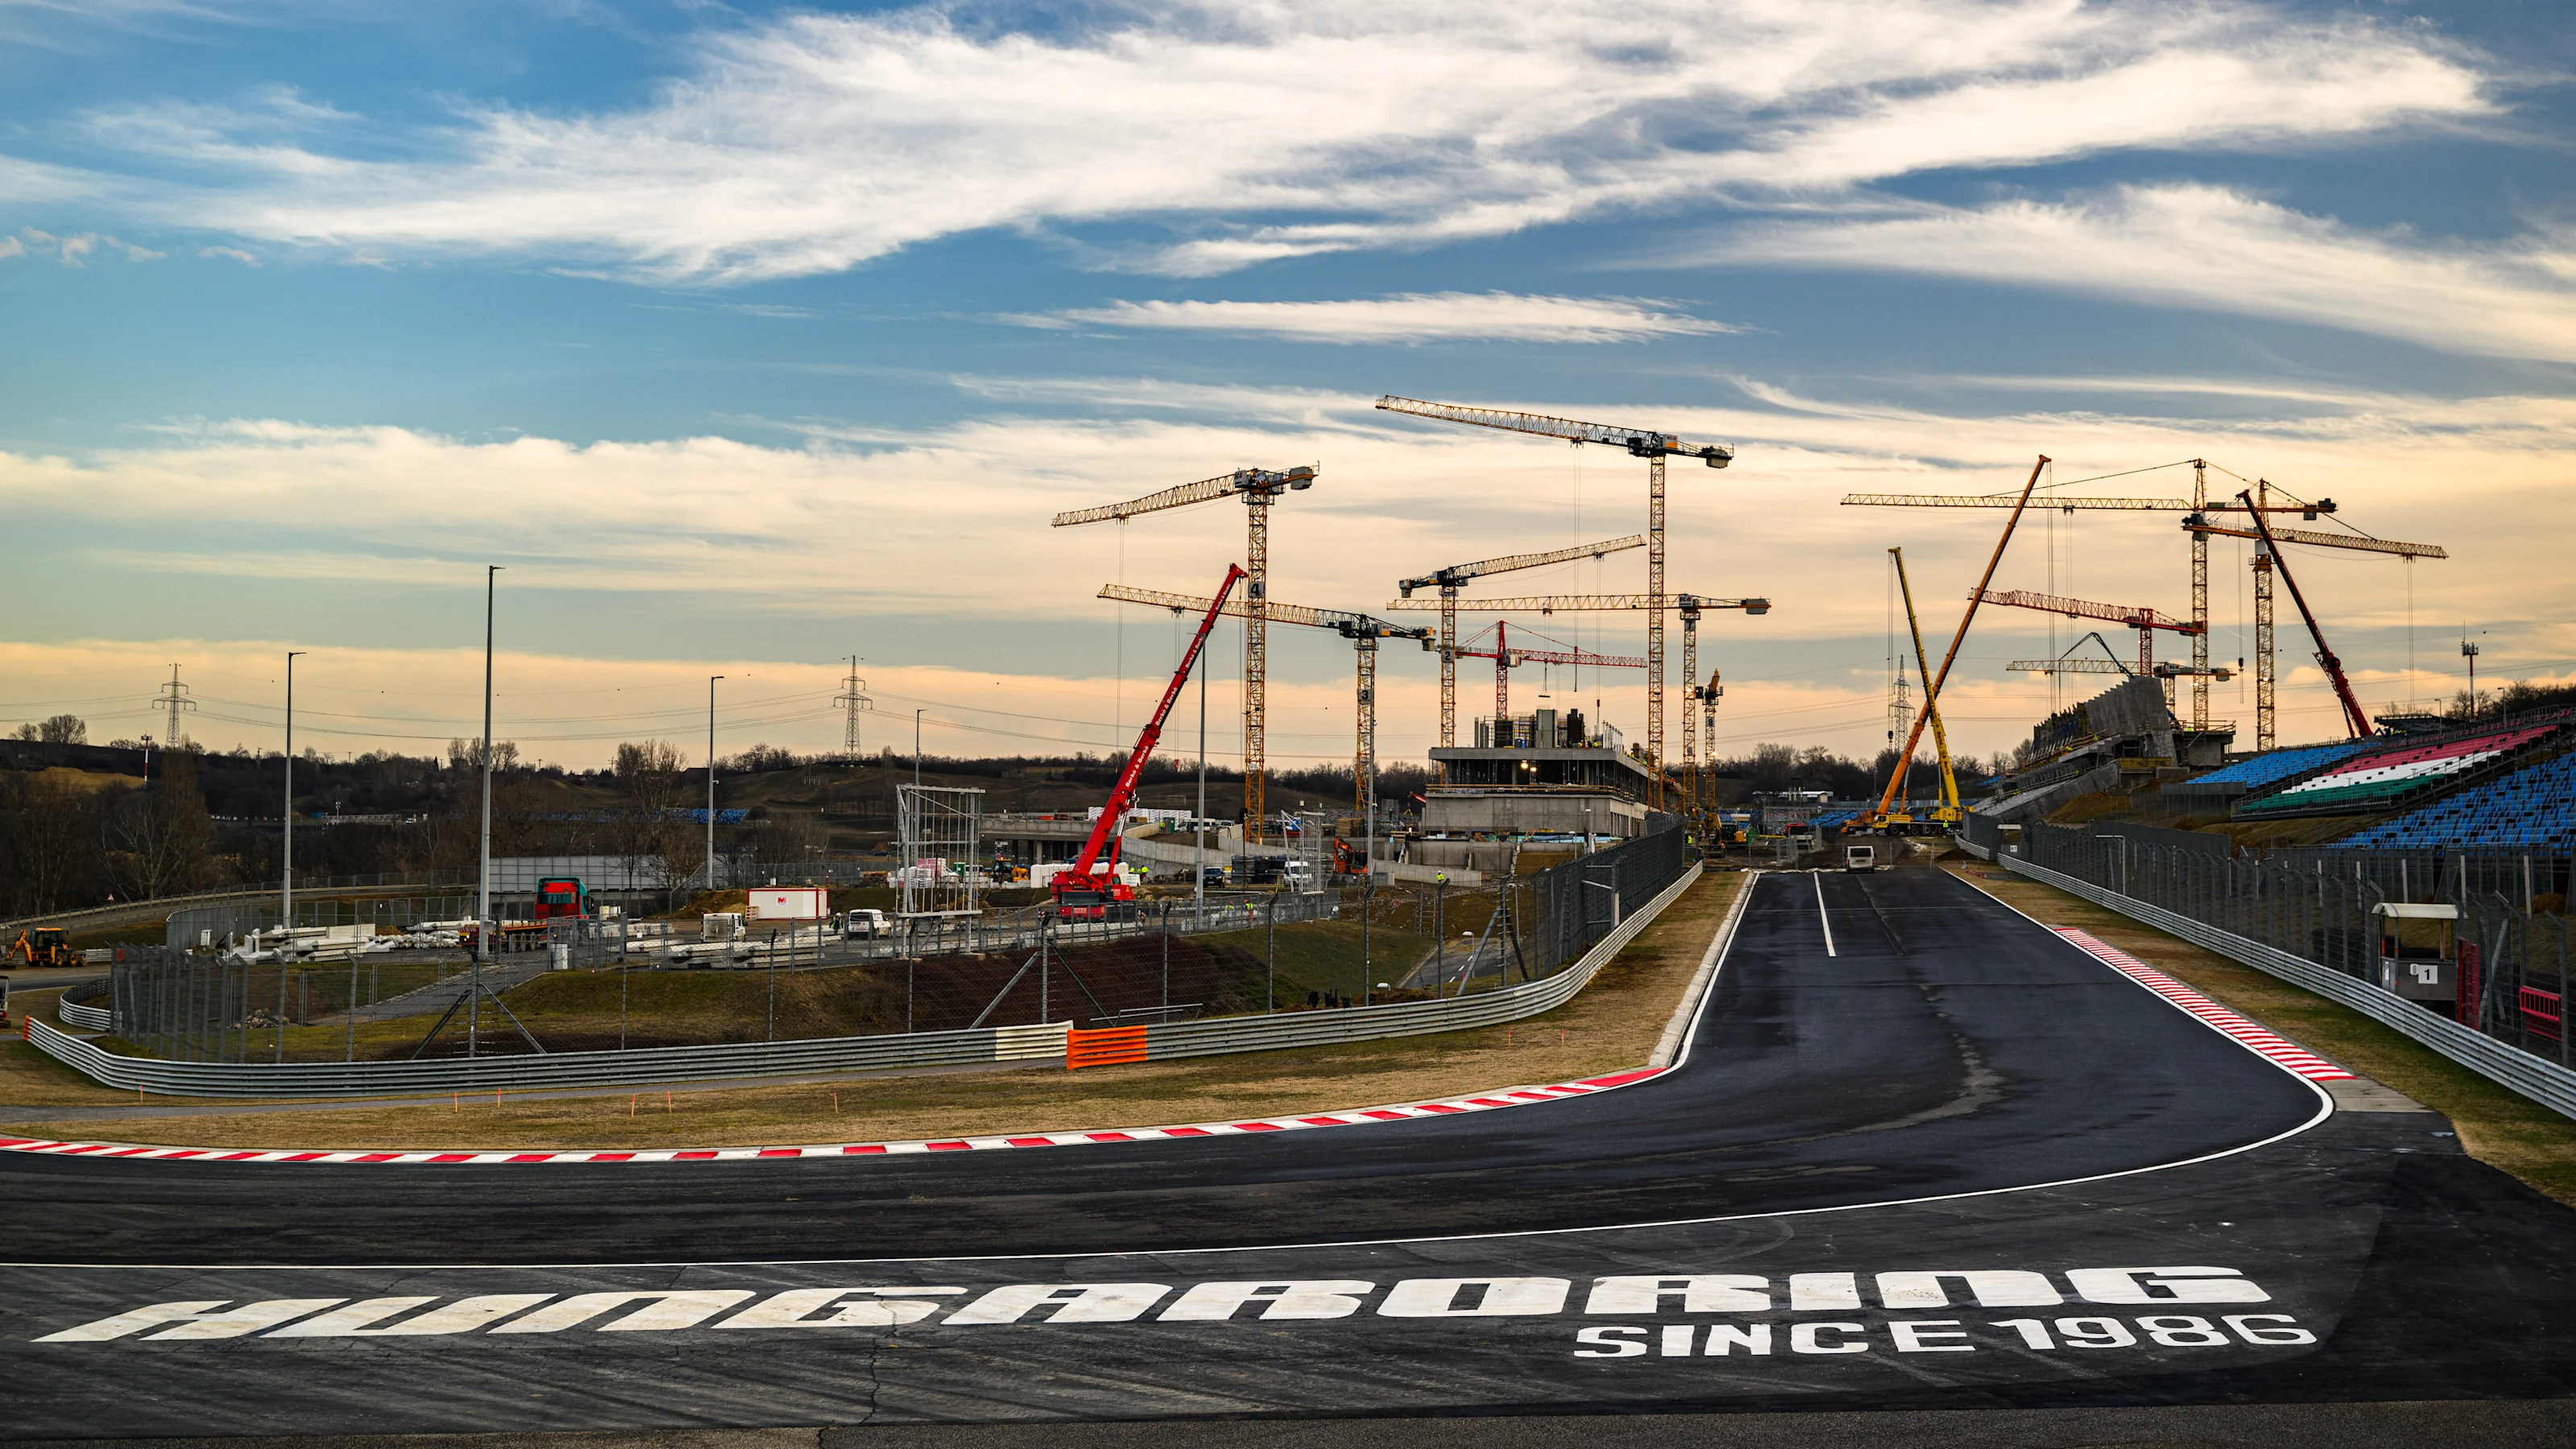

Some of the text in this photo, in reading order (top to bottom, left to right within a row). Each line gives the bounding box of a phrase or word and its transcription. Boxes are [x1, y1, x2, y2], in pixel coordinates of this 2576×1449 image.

[1250, 583, 1260, 596] 4
[1686, 621, 1692, 630] 7
[1445, 650, 1451, 661] 2
[1361, 690, 1368, 700] 3
[1155, 709, 1166, 726] Berkó
[1166, 687, 1178, 704] Berkó
[1125, 770, 1137, 787] Berkó
[1137, 745, 1149, 763] Berkó
[2424, 968, 2429, 980] 1
[31, 1266, 2272, 1343] HUNGARORING
[1573, 1314, 2318, 1358] SINCE 1986
